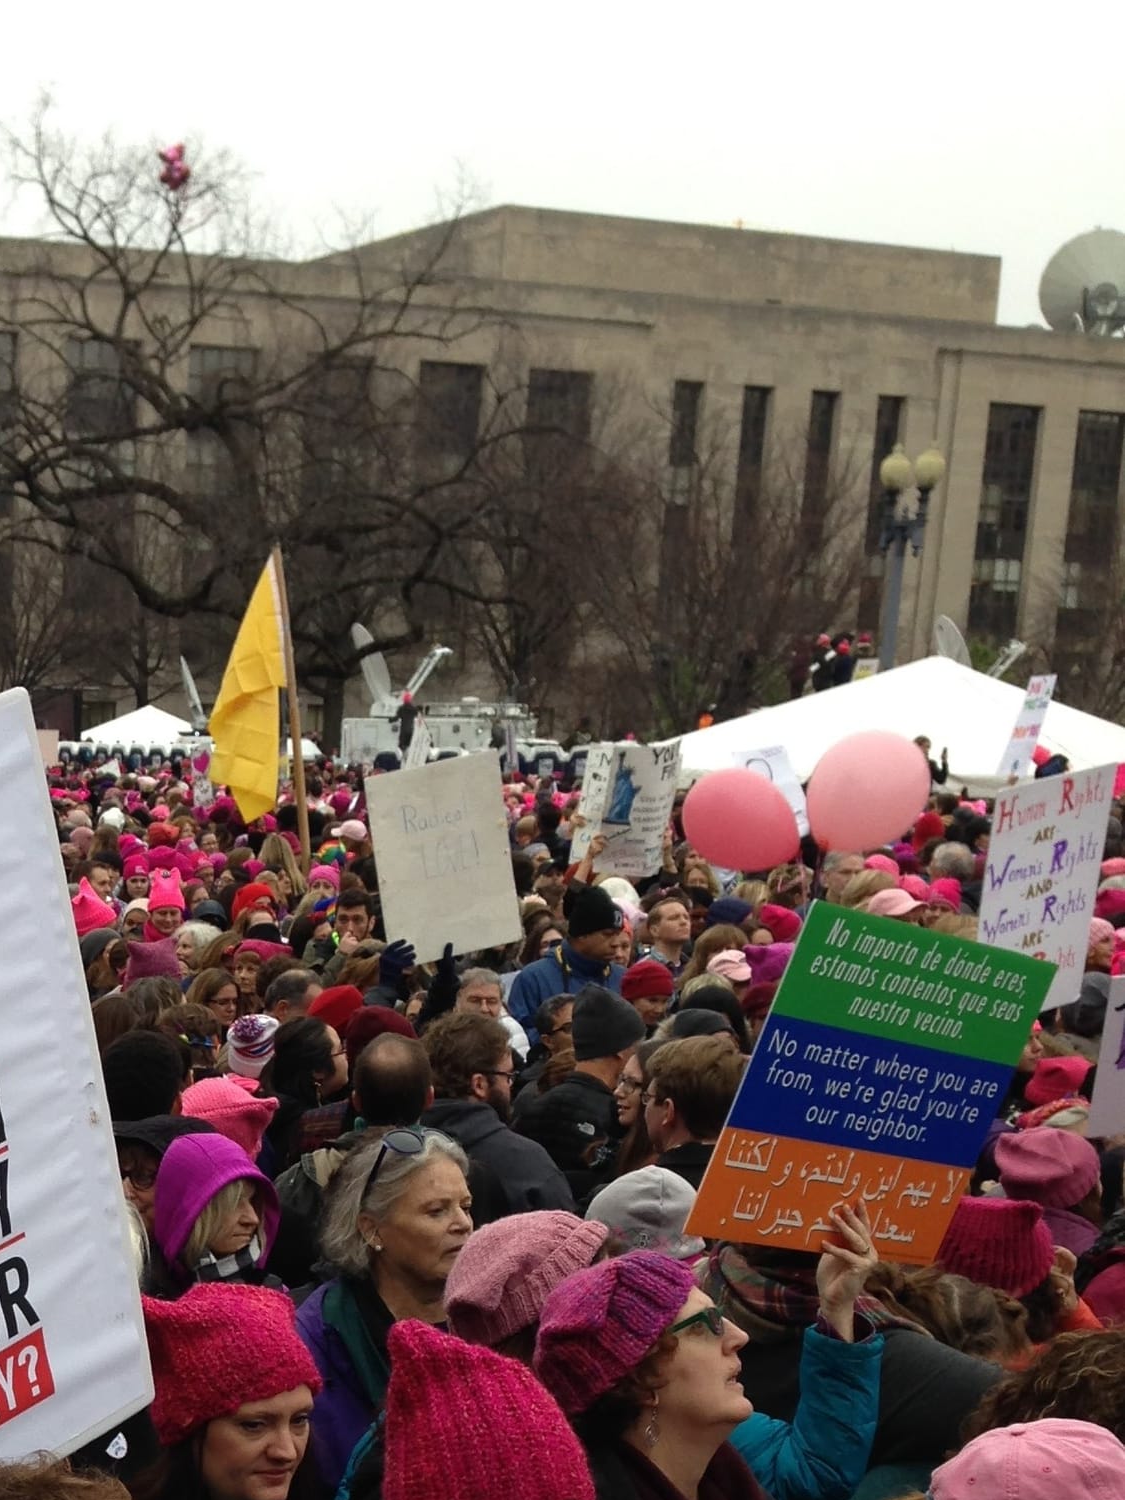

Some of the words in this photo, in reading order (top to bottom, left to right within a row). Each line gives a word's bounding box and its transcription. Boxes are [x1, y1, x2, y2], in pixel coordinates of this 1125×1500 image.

[1059, 772, 1105, 818] Rights
[1049, 831, 1099, 877] Rights
[1041, 888, 1086, 925] Rights
[825, 917, 849, 949] No
[852, 926, 920, 968] importa
[920, 942, 941, 971] de
[944, 944, 991, 985] dónde
[992, 969, 1028, 998] eres,
[810, 953, 879, 988] estamos
[881, 968, 954, 1007] contentos
[959, 990, 986, 1016] que
[991, 996, 1024, 1022] seas
[848, 994, 910, 1027] nuestro
[914, 1008, 964, 1040] vecino.
[768, 1028, 798, 1057] No
[804, 1037, 866, 1072] matter
[874, 1053, 929, 1083] where
[931, 1074, 965, 1096] you
[970, 1076, 999, 1098] are
[766, 1061, 815, 1096] from,
[826, 1076, 875, 1104] we're
[878, 1086, 922, 1115] glad
[925, 1095, 980, 1124] you're
[806, 1105, 839, 1127] our
[844, 1109, 928, 1142] neighbor.
[901, 1180, 936, 1209] يهم
[941, 1168, 964, 1204] لا
